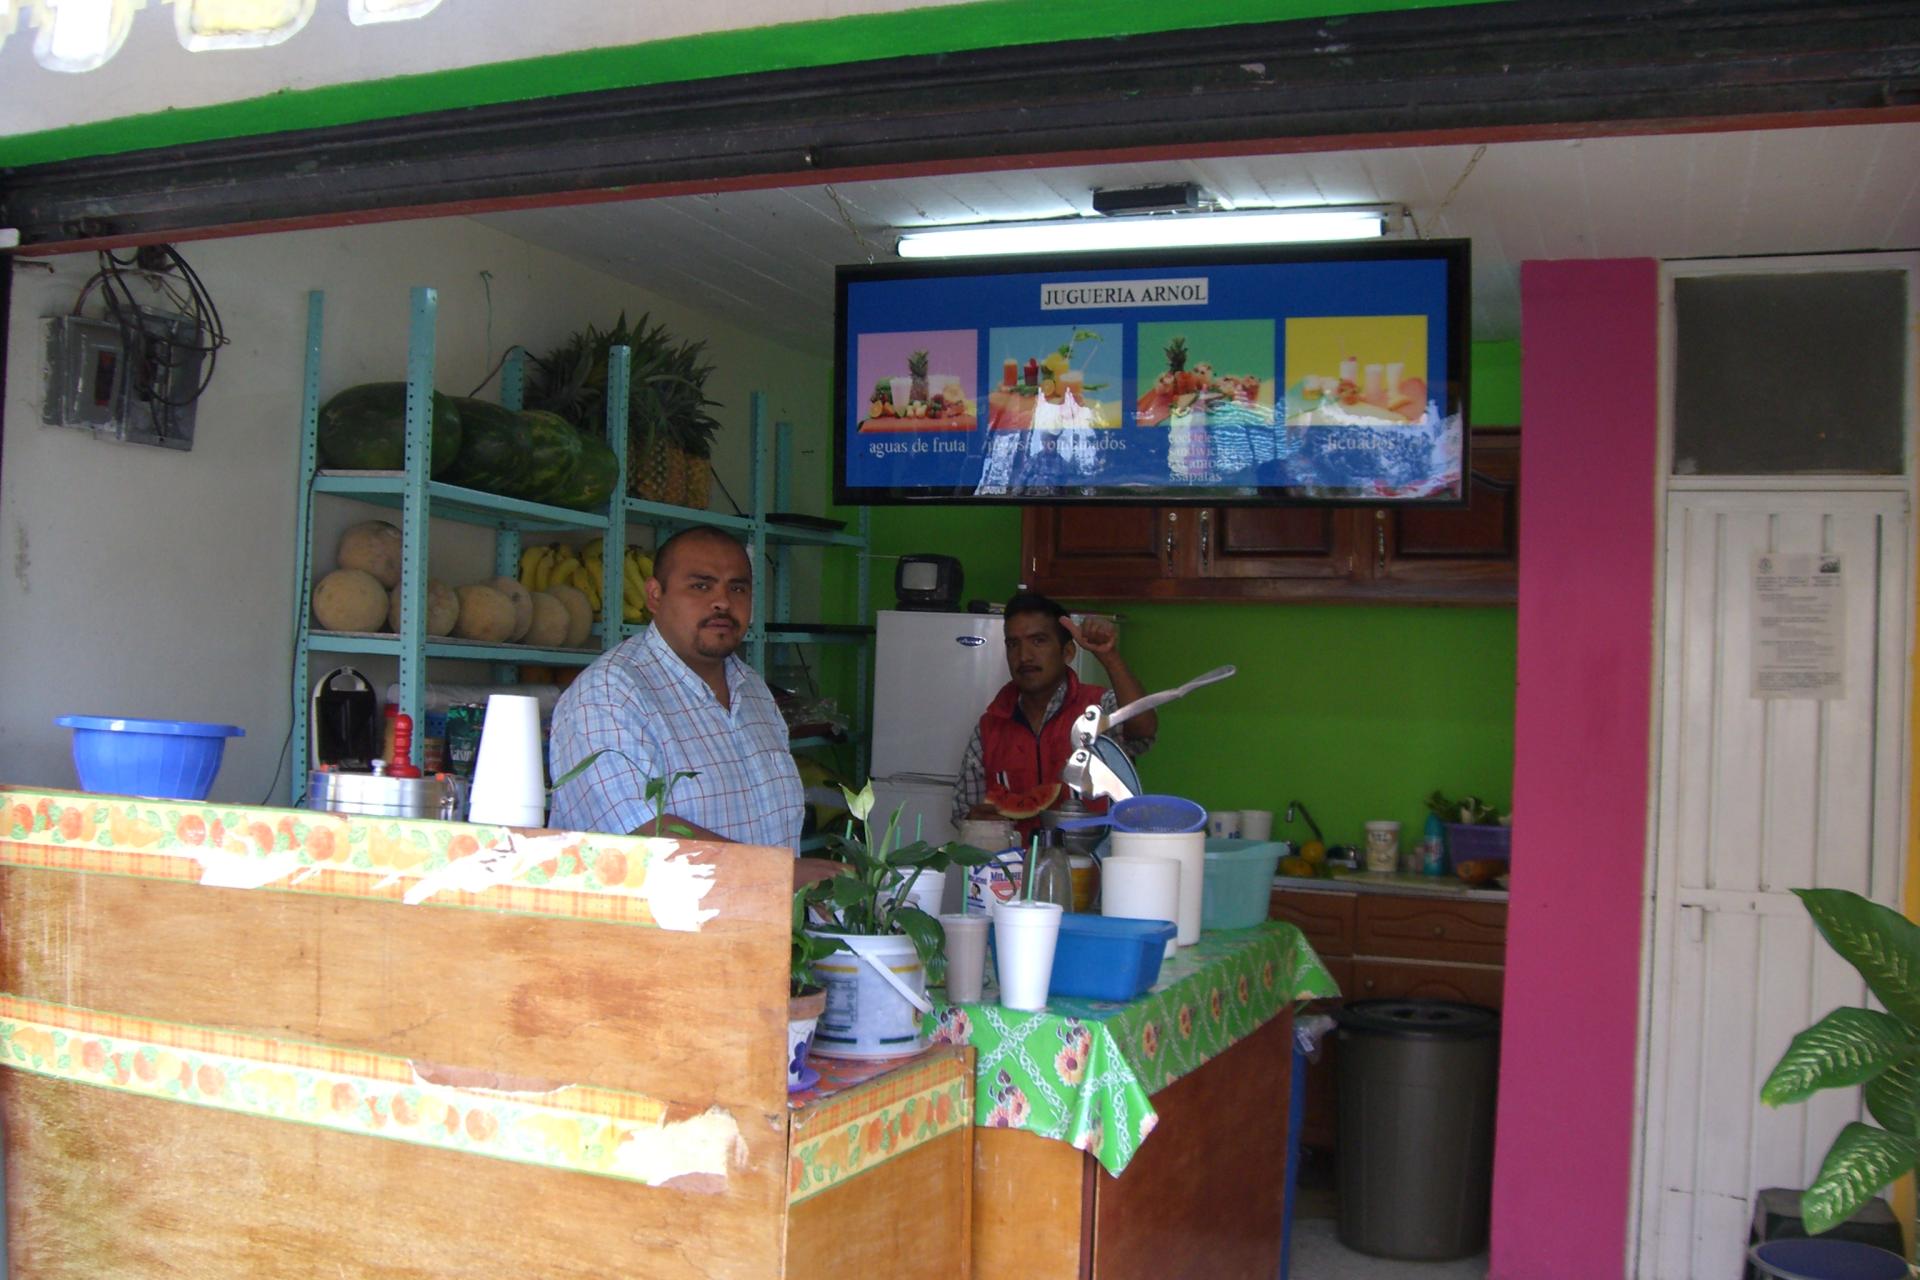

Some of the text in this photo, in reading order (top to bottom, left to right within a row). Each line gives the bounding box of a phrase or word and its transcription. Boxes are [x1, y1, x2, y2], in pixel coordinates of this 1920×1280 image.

[1044, 284, 1207, 306] JUGUERIA ARNOL
[869, 436, 967, 459] aguas de fruta
[1327, 433, 1395, 450] licuados
[990, 871, 1022, 882] MILHE
